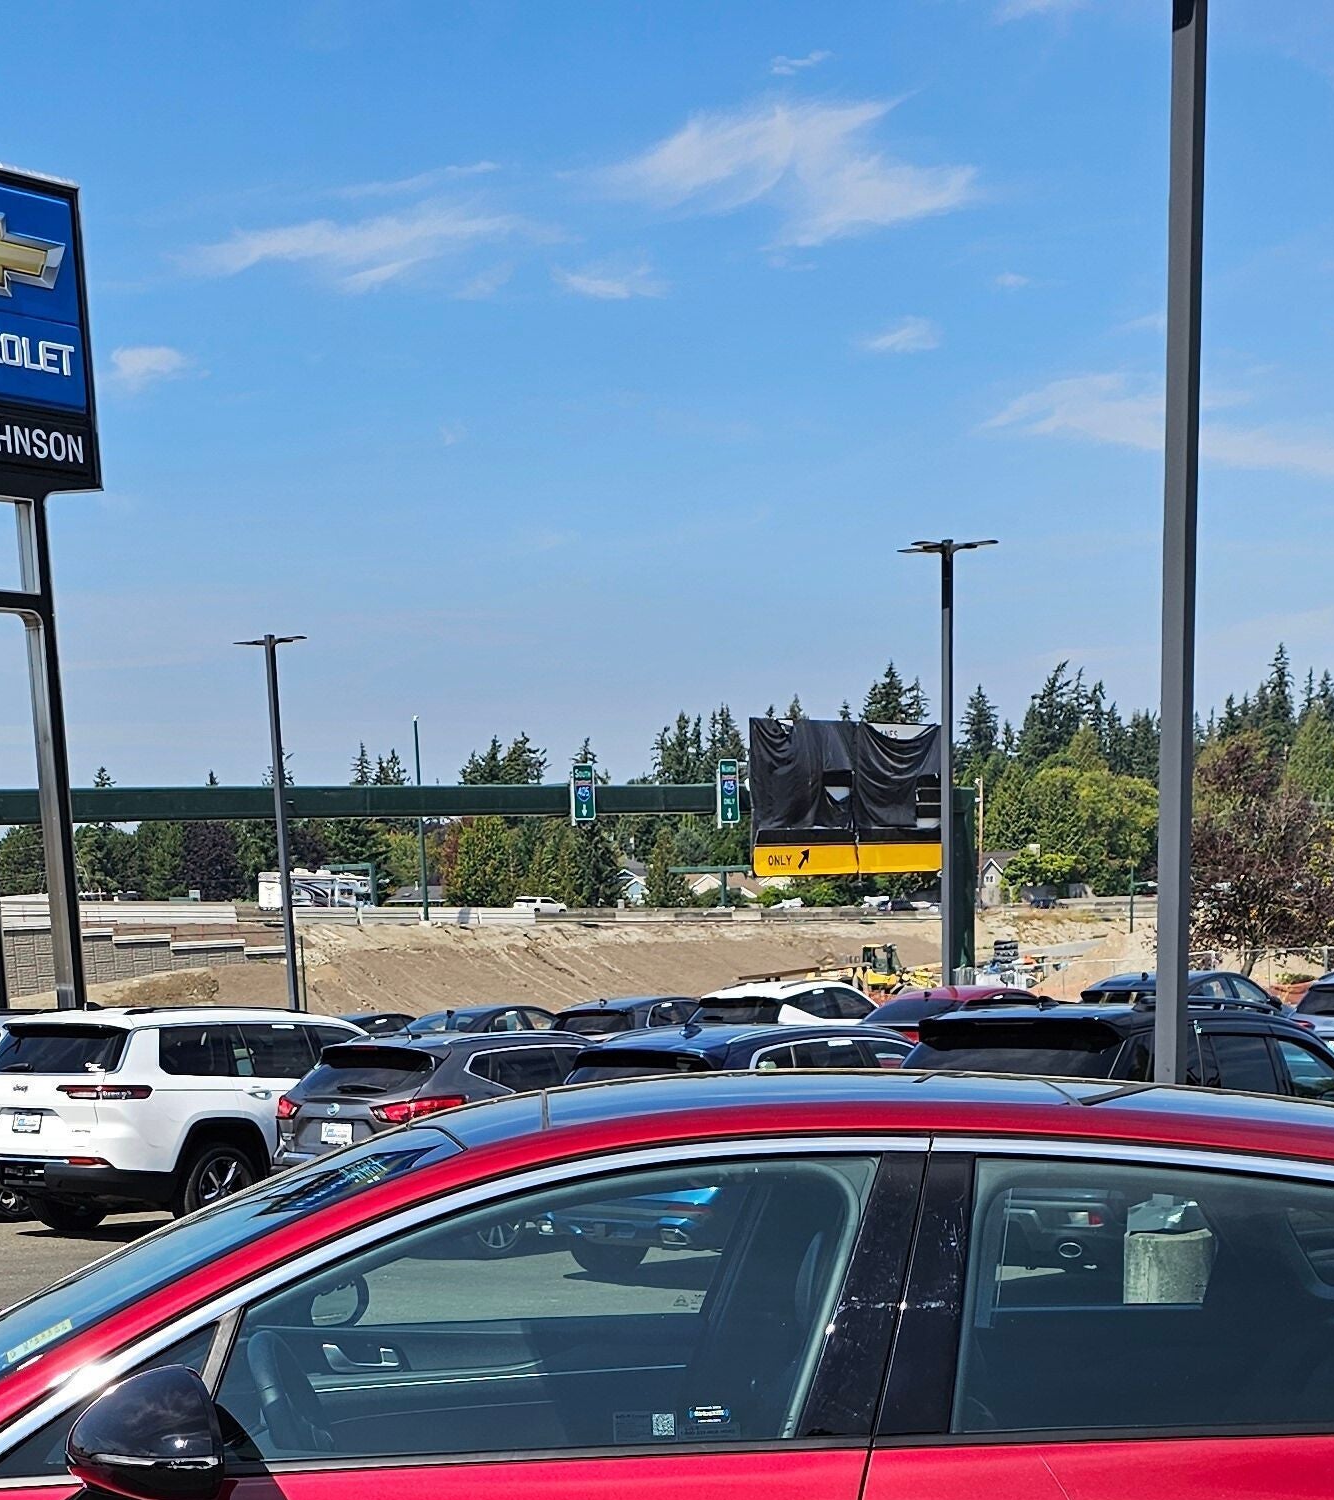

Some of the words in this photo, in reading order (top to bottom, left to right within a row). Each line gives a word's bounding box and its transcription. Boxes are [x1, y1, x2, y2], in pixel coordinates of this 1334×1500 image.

[723, 780, 735, 791] 405
[577, 786, 590, 797] 405
[768, 854, 793, 866] ONLY
